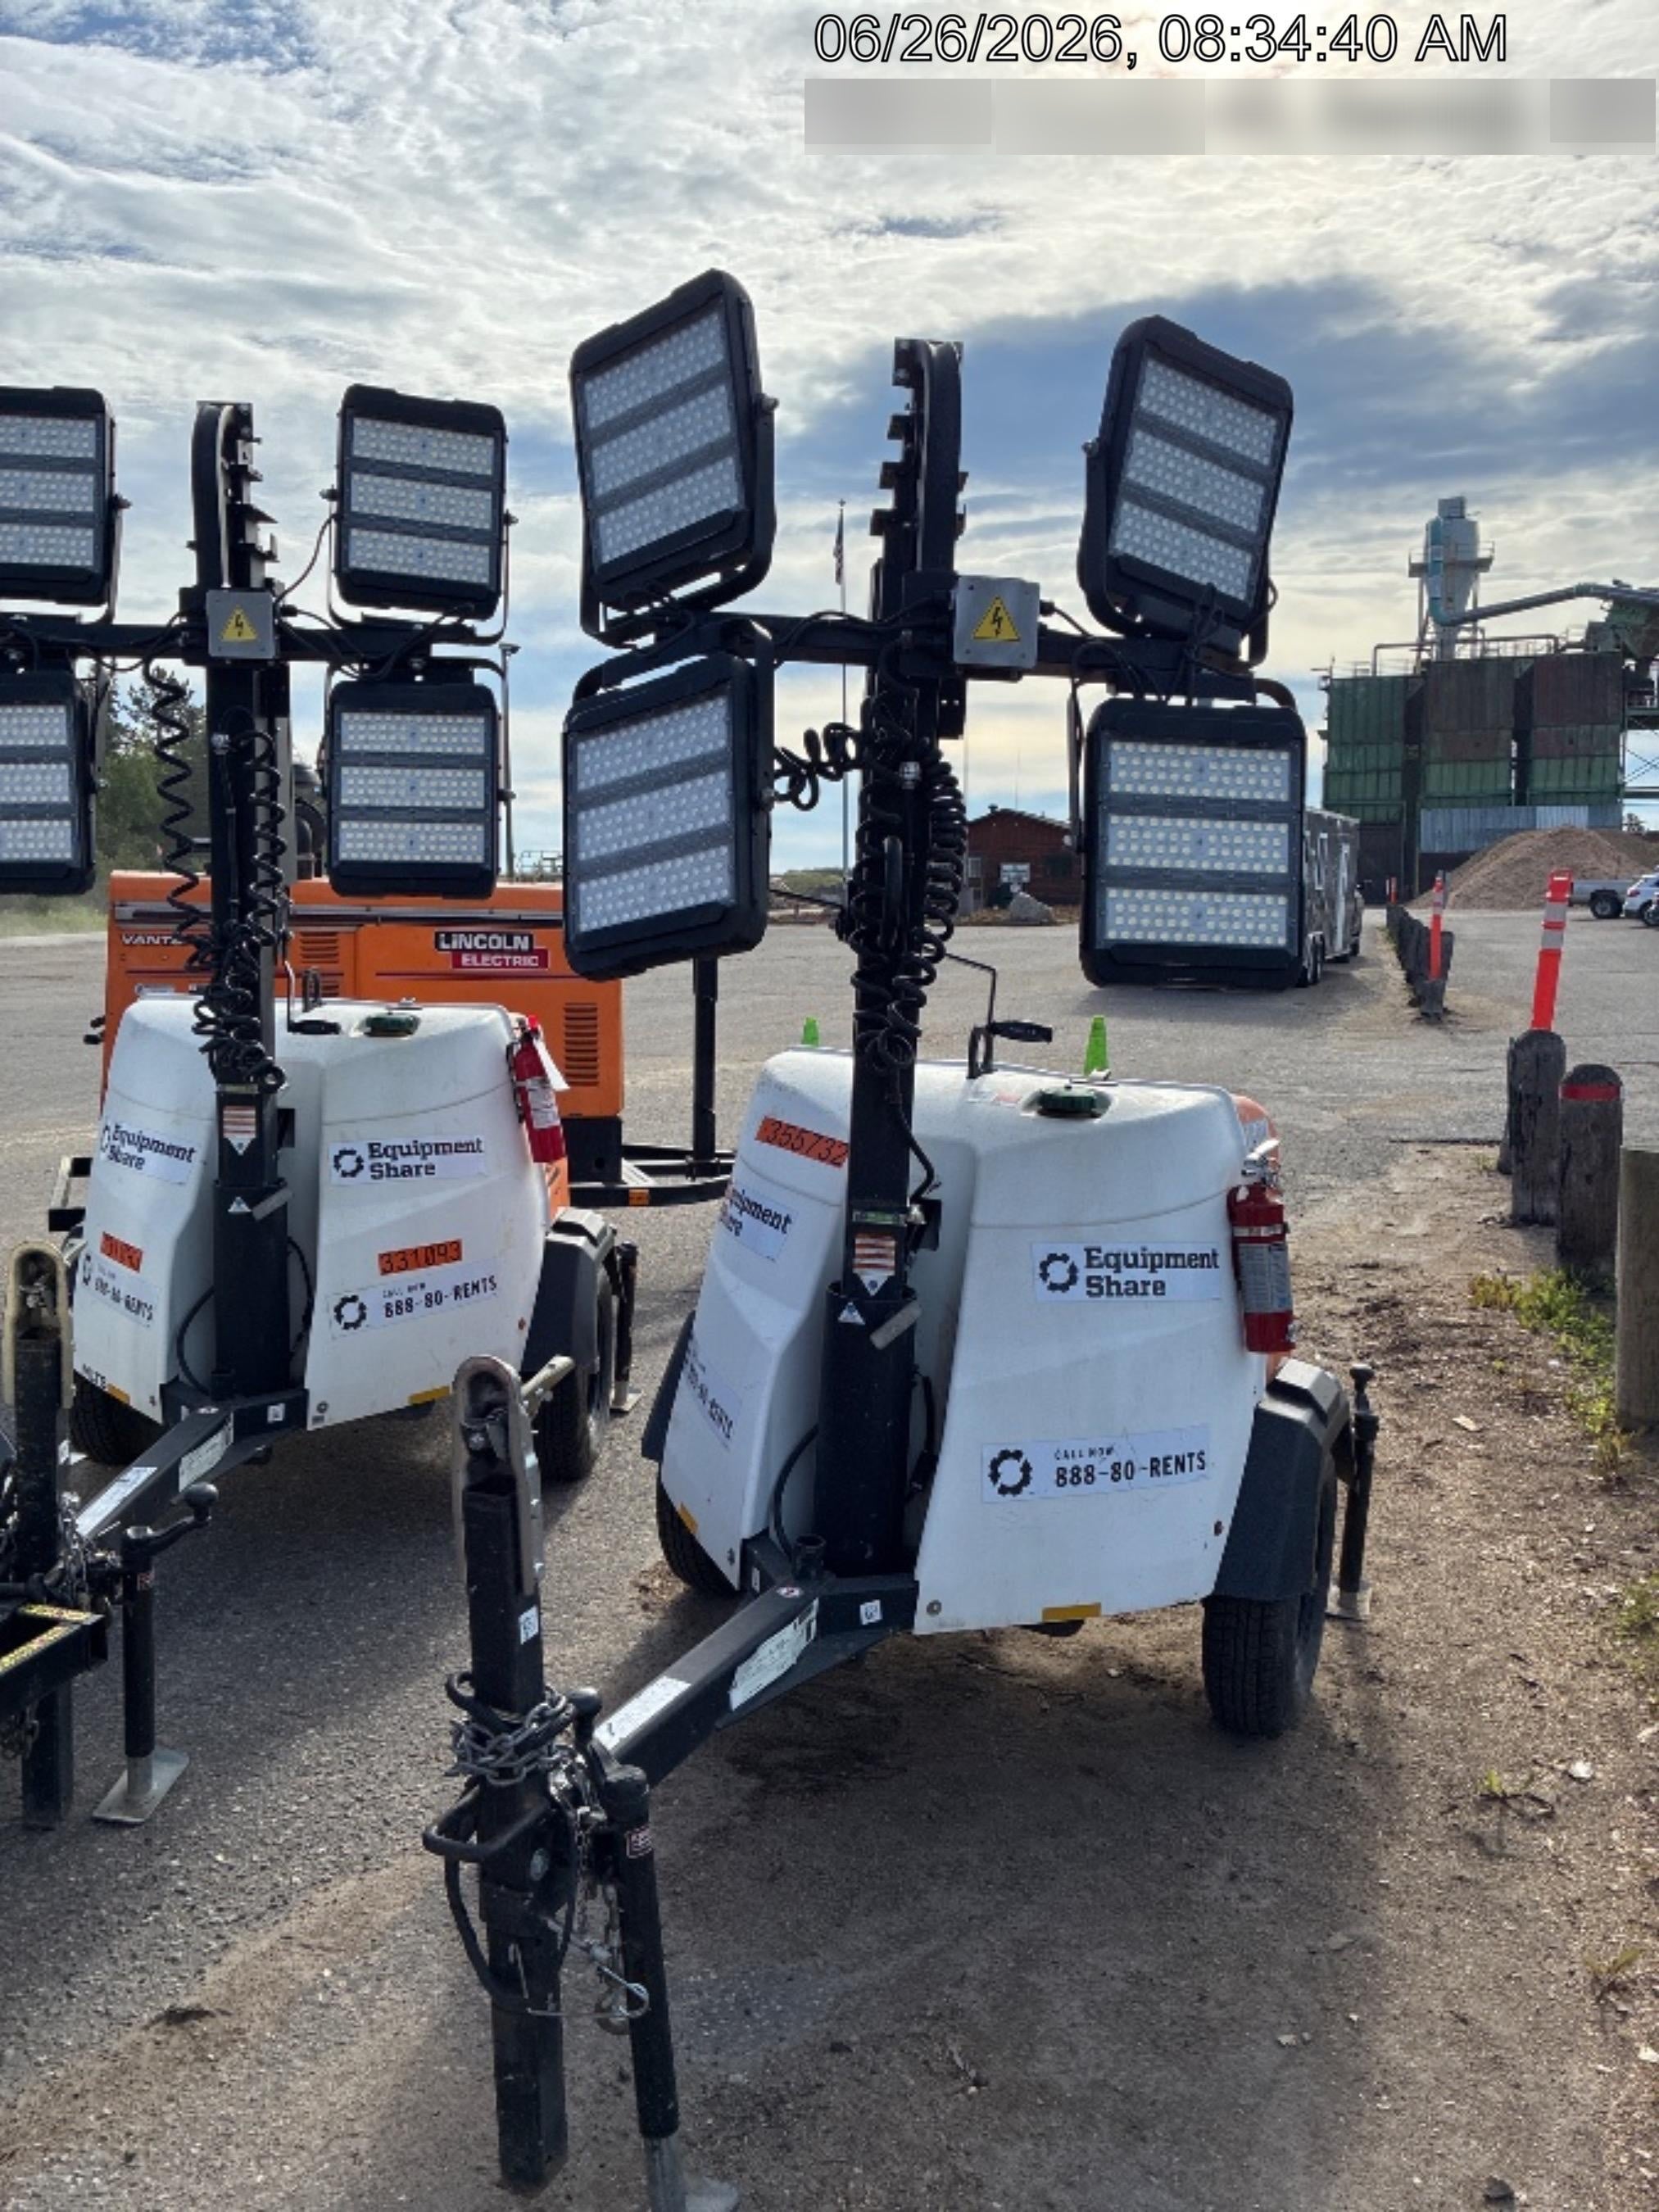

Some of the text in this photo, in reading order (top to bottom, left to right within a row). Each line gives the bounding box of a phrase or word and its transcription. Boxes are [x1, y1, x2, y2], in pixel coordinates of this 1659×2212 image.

[438, 932, 530, 951] LINCOLN
[460, 952, 540, 968] ELECTRIC
[367, 1137, 484, 1161] Equipment
[764, 1119, 848, 1167] 355732
[369, 1161, 437, 1181] Share
[379, 1239, 462, 1275] 331093
[1083, 1245, 1220, 1273] Equipment
[383, 1275, 498, 1318] 888-80-RENTS
[1085, 1275, 1166, 1299] Share
[1054, 1445, 1114, 1461] CALL NOW
[1055, 1449, 1206, 1489] 888-80-RENTS
